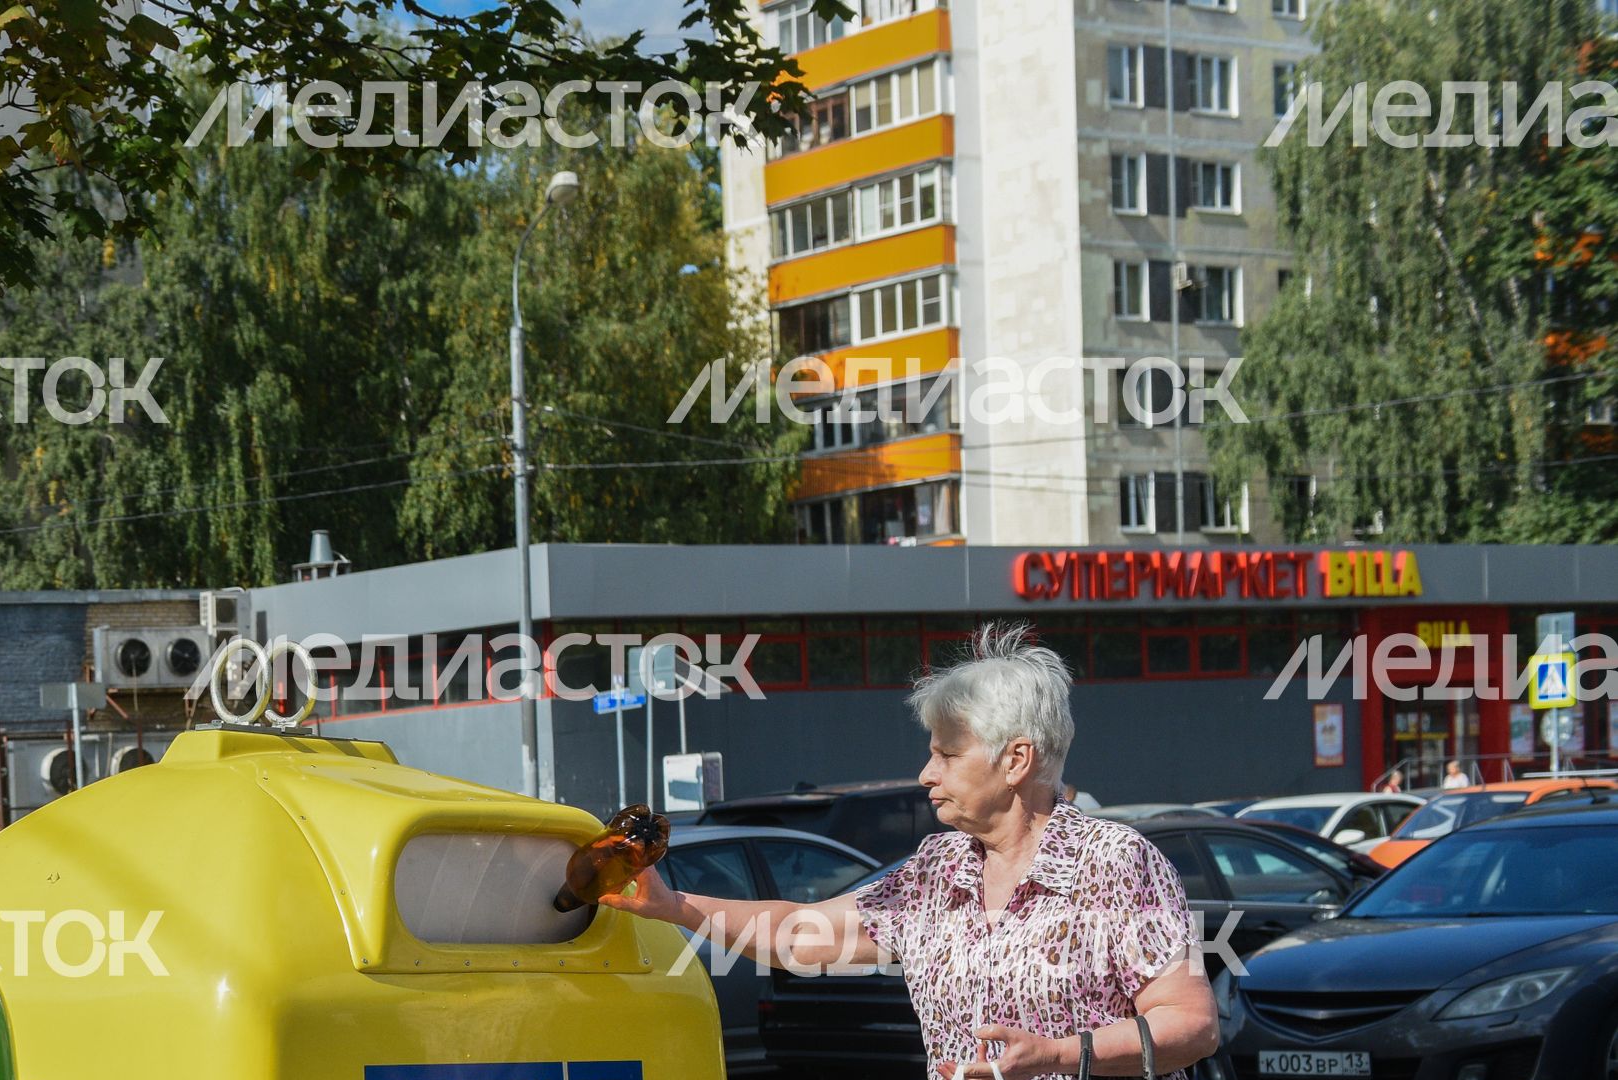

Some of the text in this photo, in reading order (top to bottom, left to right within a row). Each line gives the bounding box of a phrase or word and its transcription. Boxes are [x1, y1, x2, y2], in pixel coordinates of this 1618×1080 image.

[1012, 550, 1423, 601] СУПЕРМАРКЕТ BILLA
[1417, 620, 1473, 650] BILLA
